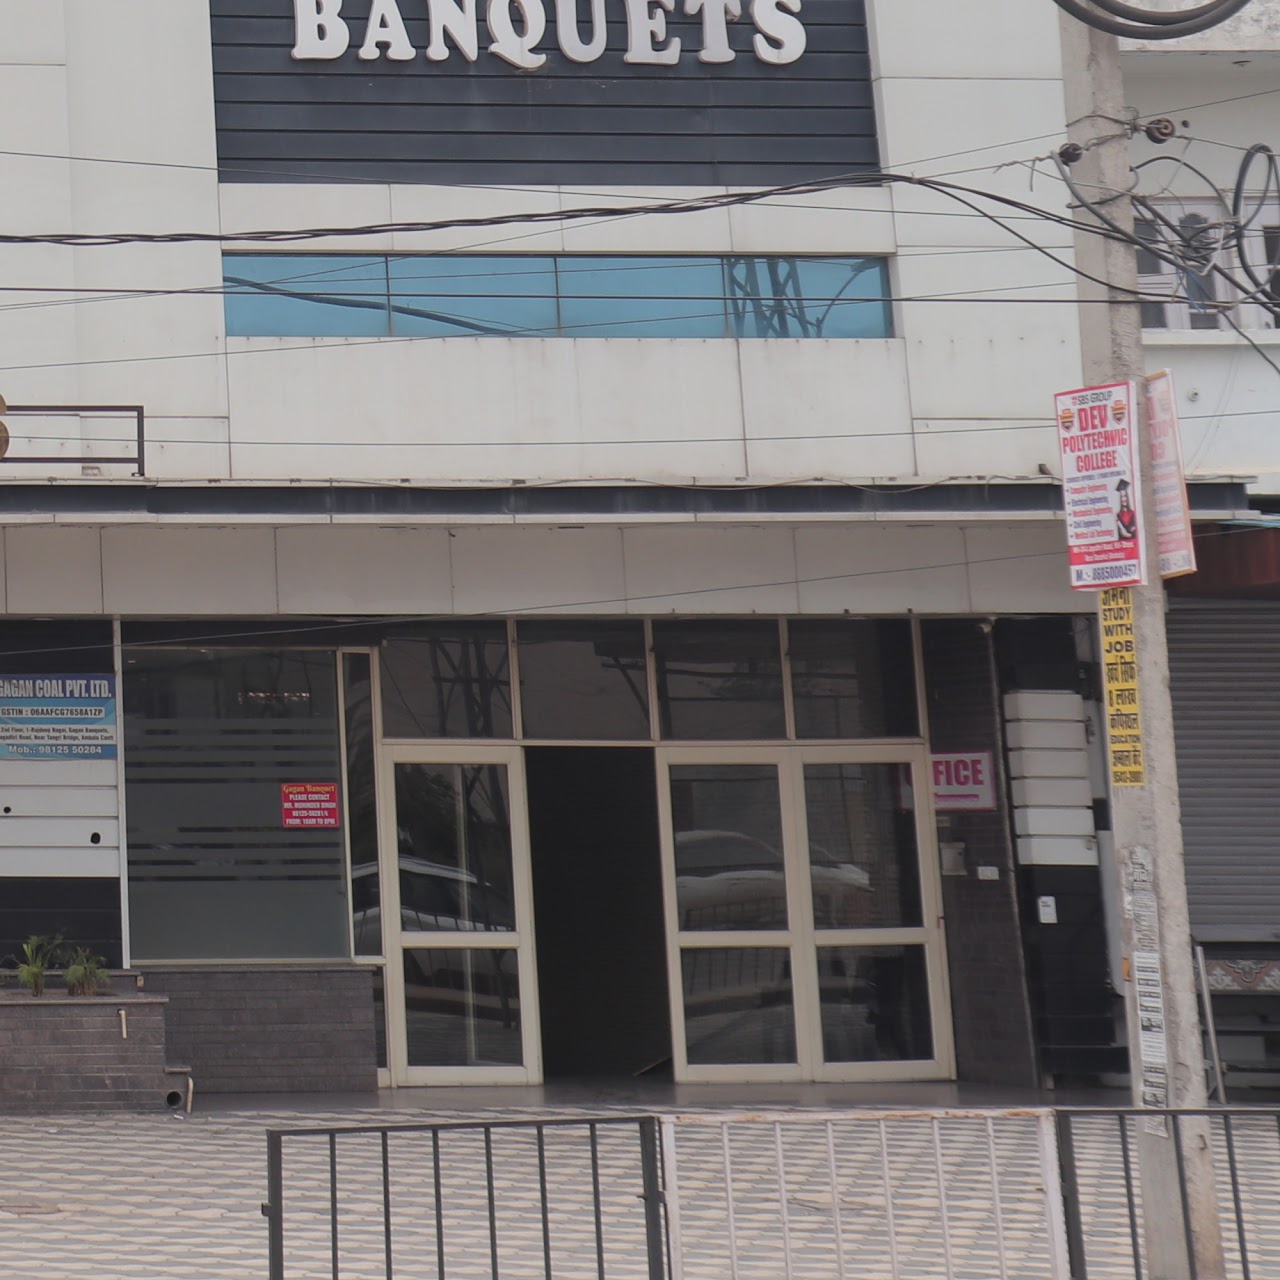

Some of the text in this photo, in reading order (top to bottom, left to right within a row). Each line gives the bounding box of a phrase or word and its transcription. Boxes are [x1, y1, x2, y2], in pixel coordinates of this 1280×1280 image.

[1091, 390, 1113, 402] GROUP
[1077, 404, 1108, 432] DEV
[1062, 428, 1128, 454] POLYTECHNIC
[1076, 450, 1118, 473] COLLEGE
[1103, 607, 1131, 622] STUDY
[1104, 623, 1133, 637] WITH
[1105, 640, 1135, 653] JOB
[35, 679, 64, 698] COAL
[66, 680, 88, 698] PVT.
[91, 680, 112, 698] LTD.
[1, 708, 24, 716] GSTIN
[38, 745, 69, 754] 98125
[72, 745, 102, 754] 50284
[283, 785, 305, 793] Gagan
